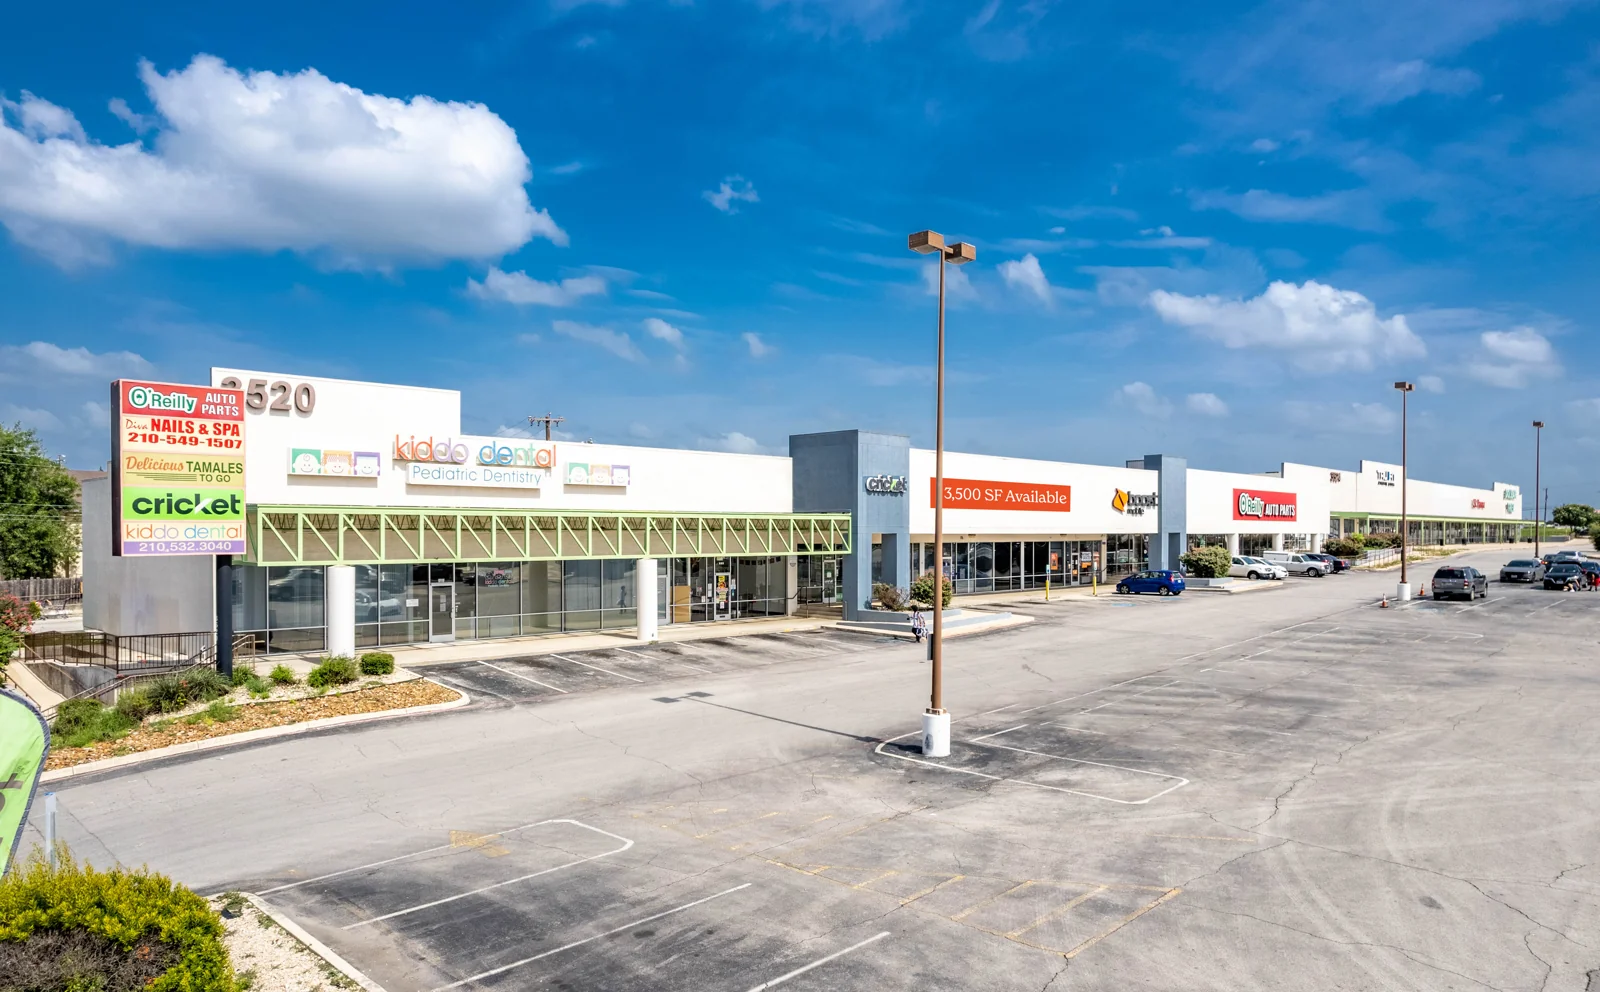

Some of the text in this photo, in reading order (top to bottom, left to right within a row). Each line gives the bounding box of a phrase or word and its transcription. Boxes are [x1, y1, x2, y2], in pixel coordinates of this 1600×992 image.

[129, 386, 197, 413] O'Reilly
[205, 393, 236, 404] AUTO
[201, 405, 239, 416] PARTS
[125, 418, 240, 437] Diva NAILS & SPA
[128, 432, 242, 449] 210-549-1507
[395, 434, 557, 467] kiddo dental
[125, 456, 243, 474] Delicious TAMALES
[200, 474, 231, 483] TO GO
[412, 466, 542, 486] Pediatric Dentistry
[132, 493, 241, 515] cricket
[943, 487, 1067, 505] 3,500 SF Available
[126, 524, 242, 539] kiddo dental
[139, 542, 232, 552] 210.532.3040
